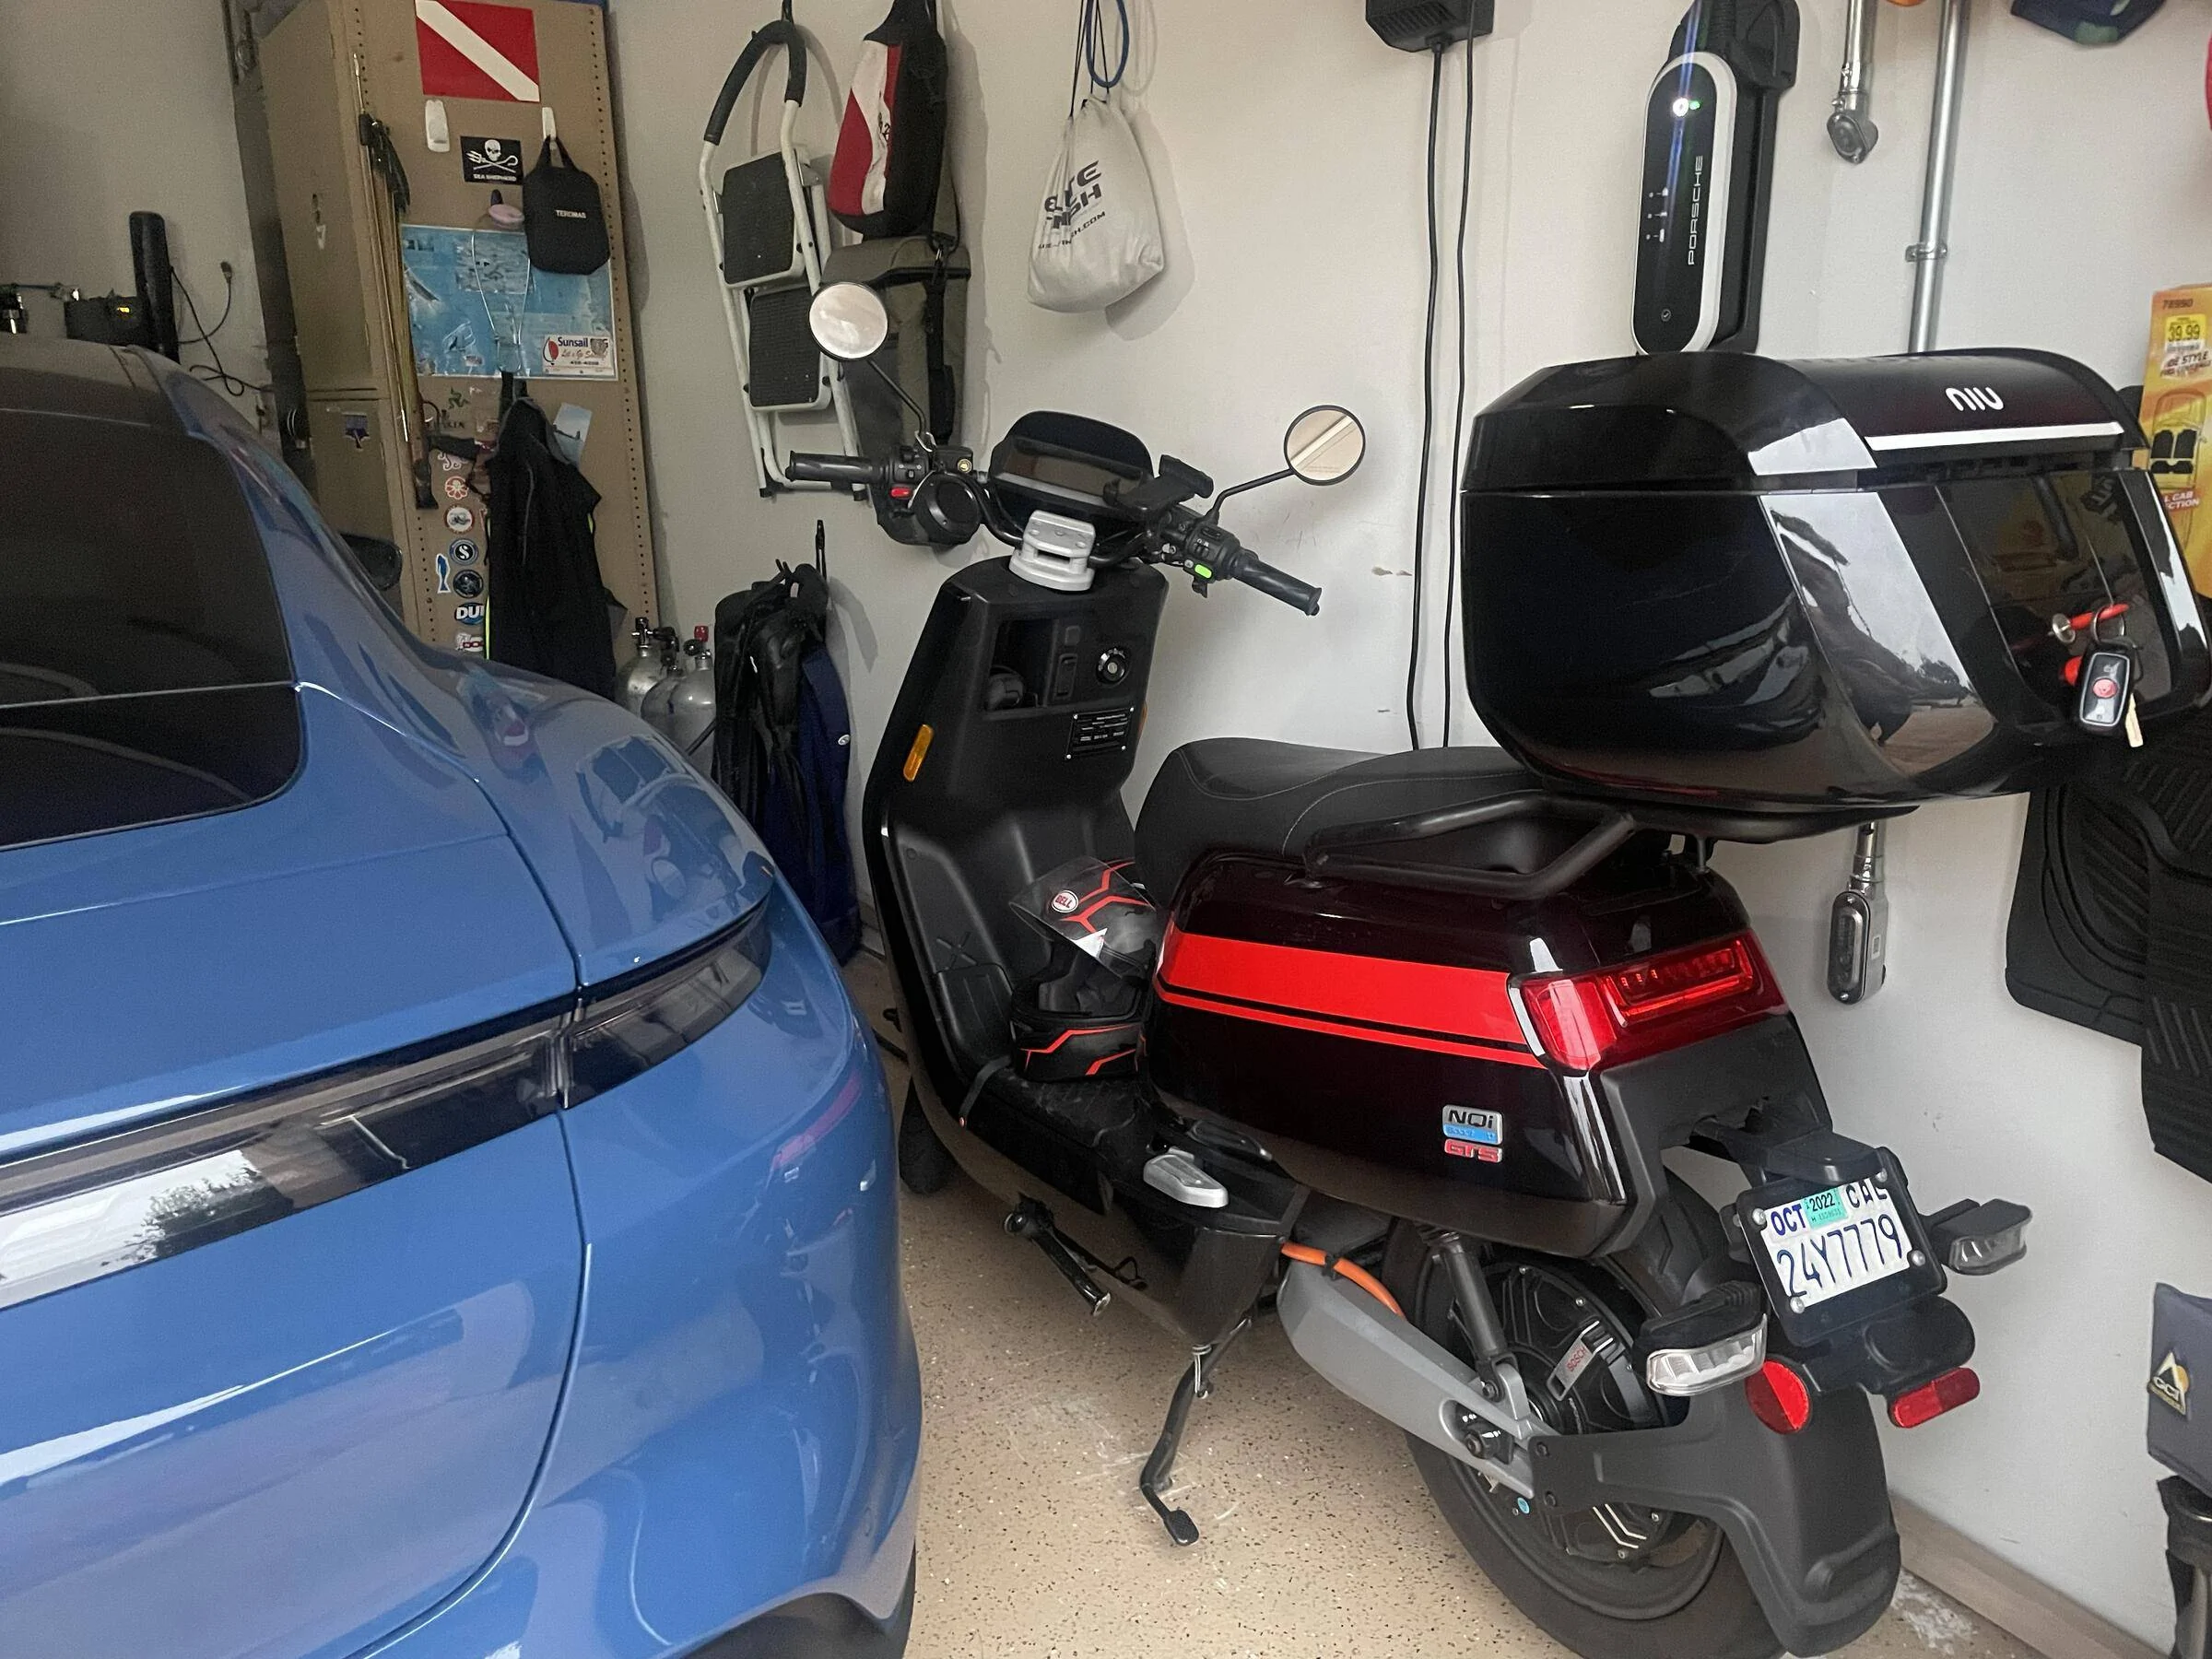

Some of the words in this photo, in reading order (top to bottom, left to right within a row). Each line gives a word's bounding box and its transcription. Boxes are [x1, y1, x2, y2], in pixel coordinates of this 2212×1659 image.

[1688, 156, 1703, 265] PORSCHE
[558, 335, 589, 347] Sunsail
[2168, 324, 2201, 342] 39.99
[1054, 894, 1073, 909] BELL
[1448, 1110, 1494, 1128] NQi
[1770, 1203, 1806, 1236] OCT
[1809, 1193, 1836, 1212] 2022
[1776, 1213, 1903, 1298] 24Y7779
[1567, 1347, 1586, 1372] BOSCH
